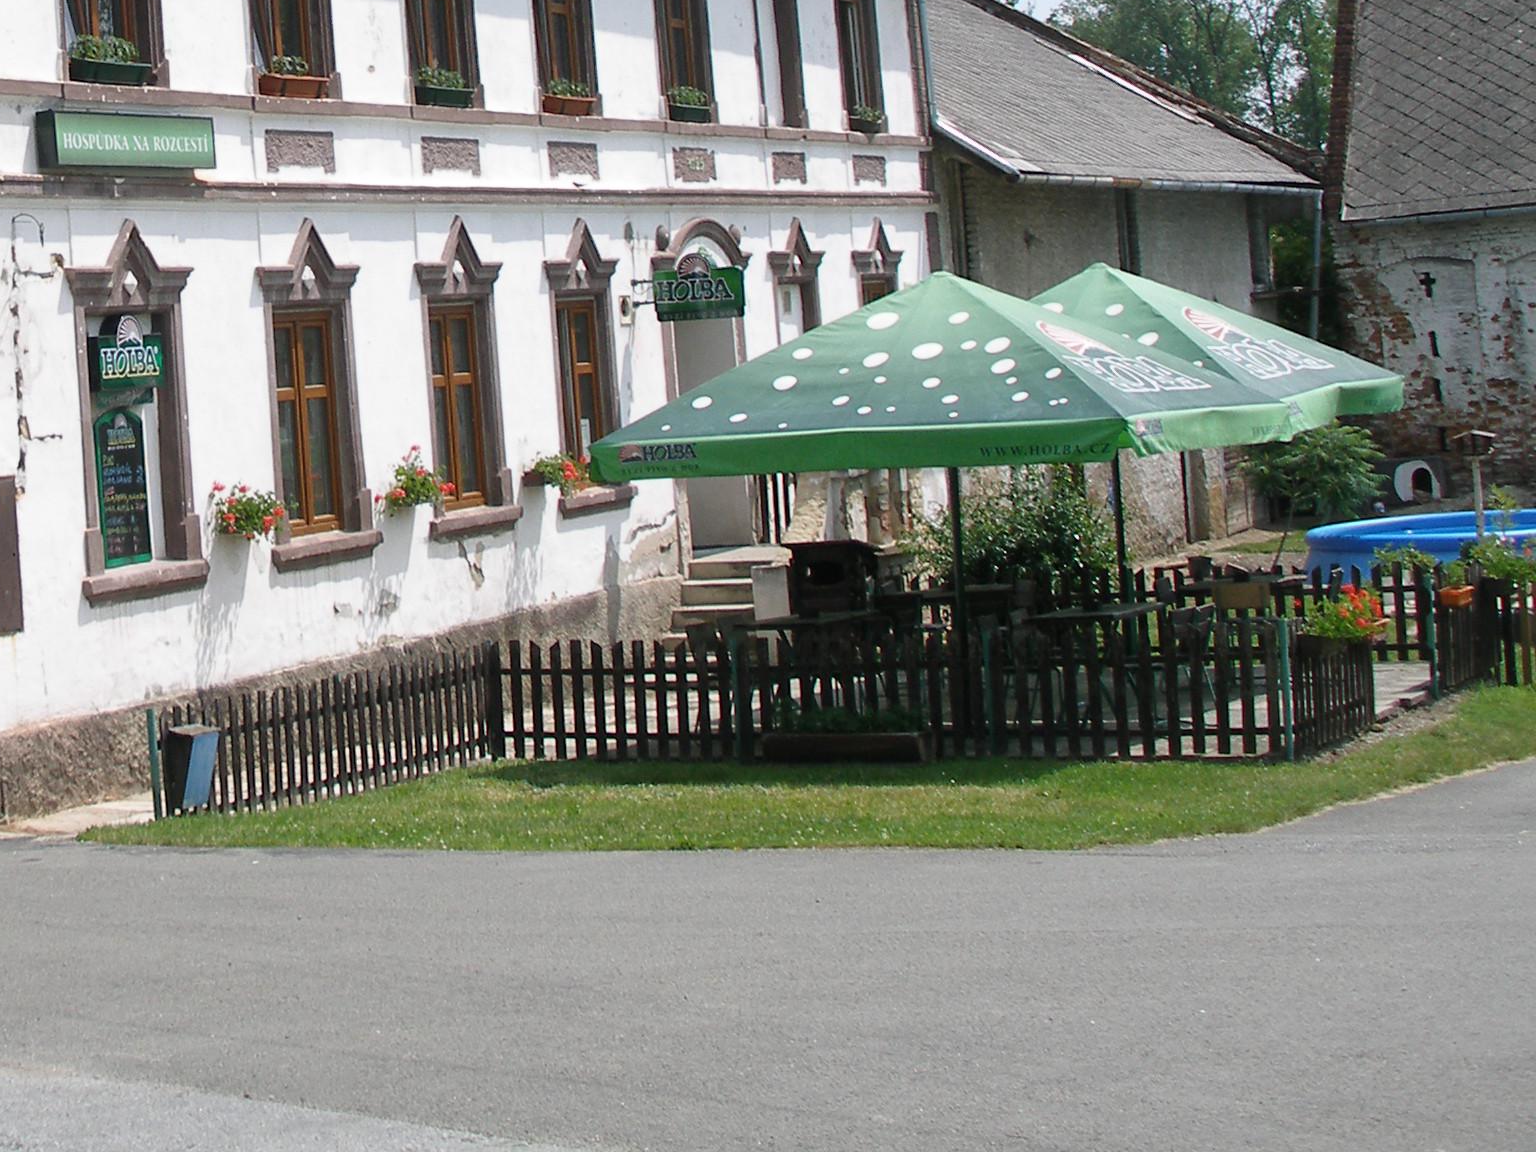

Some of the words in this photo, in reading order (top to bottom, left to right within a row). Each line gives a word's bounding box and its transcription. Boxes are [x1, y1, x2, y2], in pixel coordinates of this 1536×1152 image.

[134, 135, 149, 152] NA
[154, 134, 208, 153] ROZCESTÍ
[656, 277, 734, 303] HOLBA
[101, 346, 159, 379] HOLBA
[643, 442, 696, 461] HOLBA
